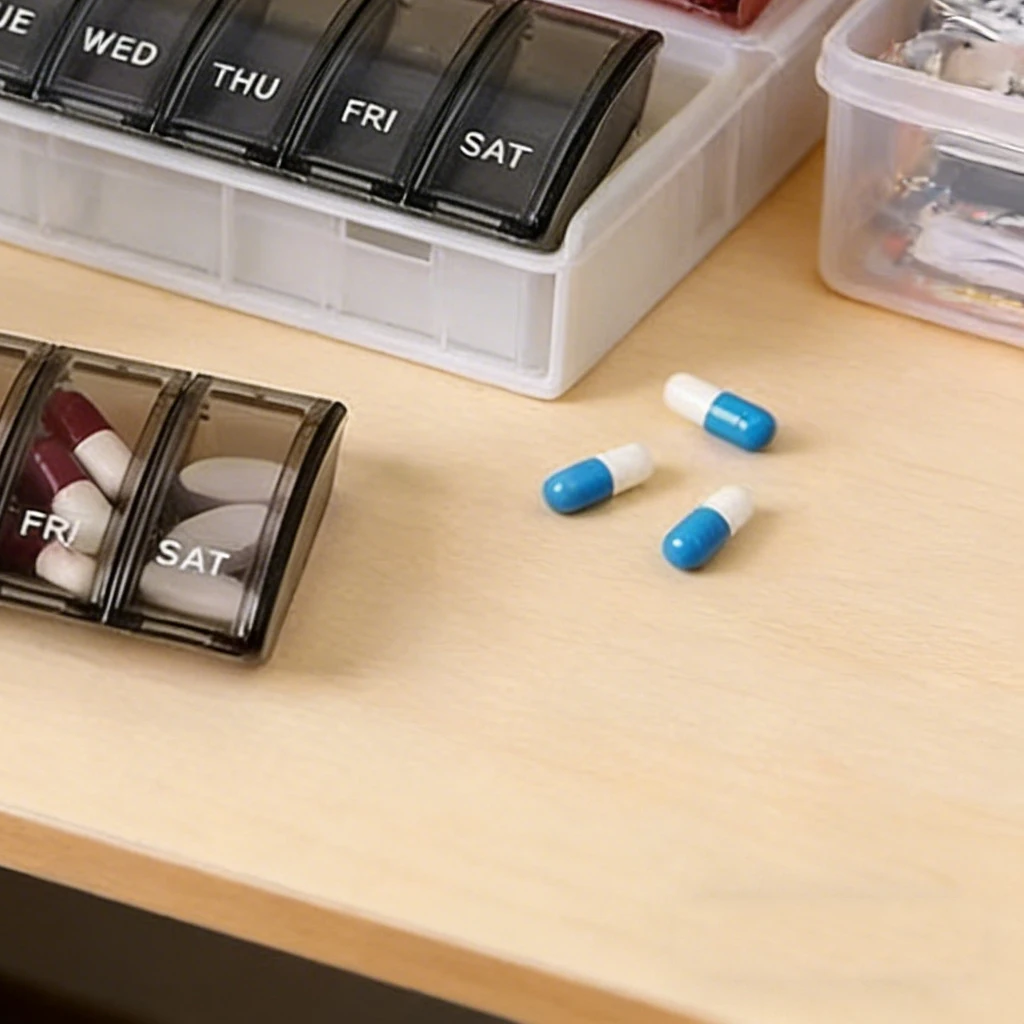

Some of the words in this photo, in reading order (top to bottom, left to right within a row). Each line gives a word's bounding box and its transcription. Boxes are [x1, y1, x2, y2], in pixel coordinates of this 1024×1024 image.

[82, 26, 158, 67] WED
[211, 61, 280, 101] THU
[339, 98, 398, 134] FRI
[459, 130, 533, 170] SAT
[19, 509, 81, 548] FRI
[156, 538, 231, 576] SAT
